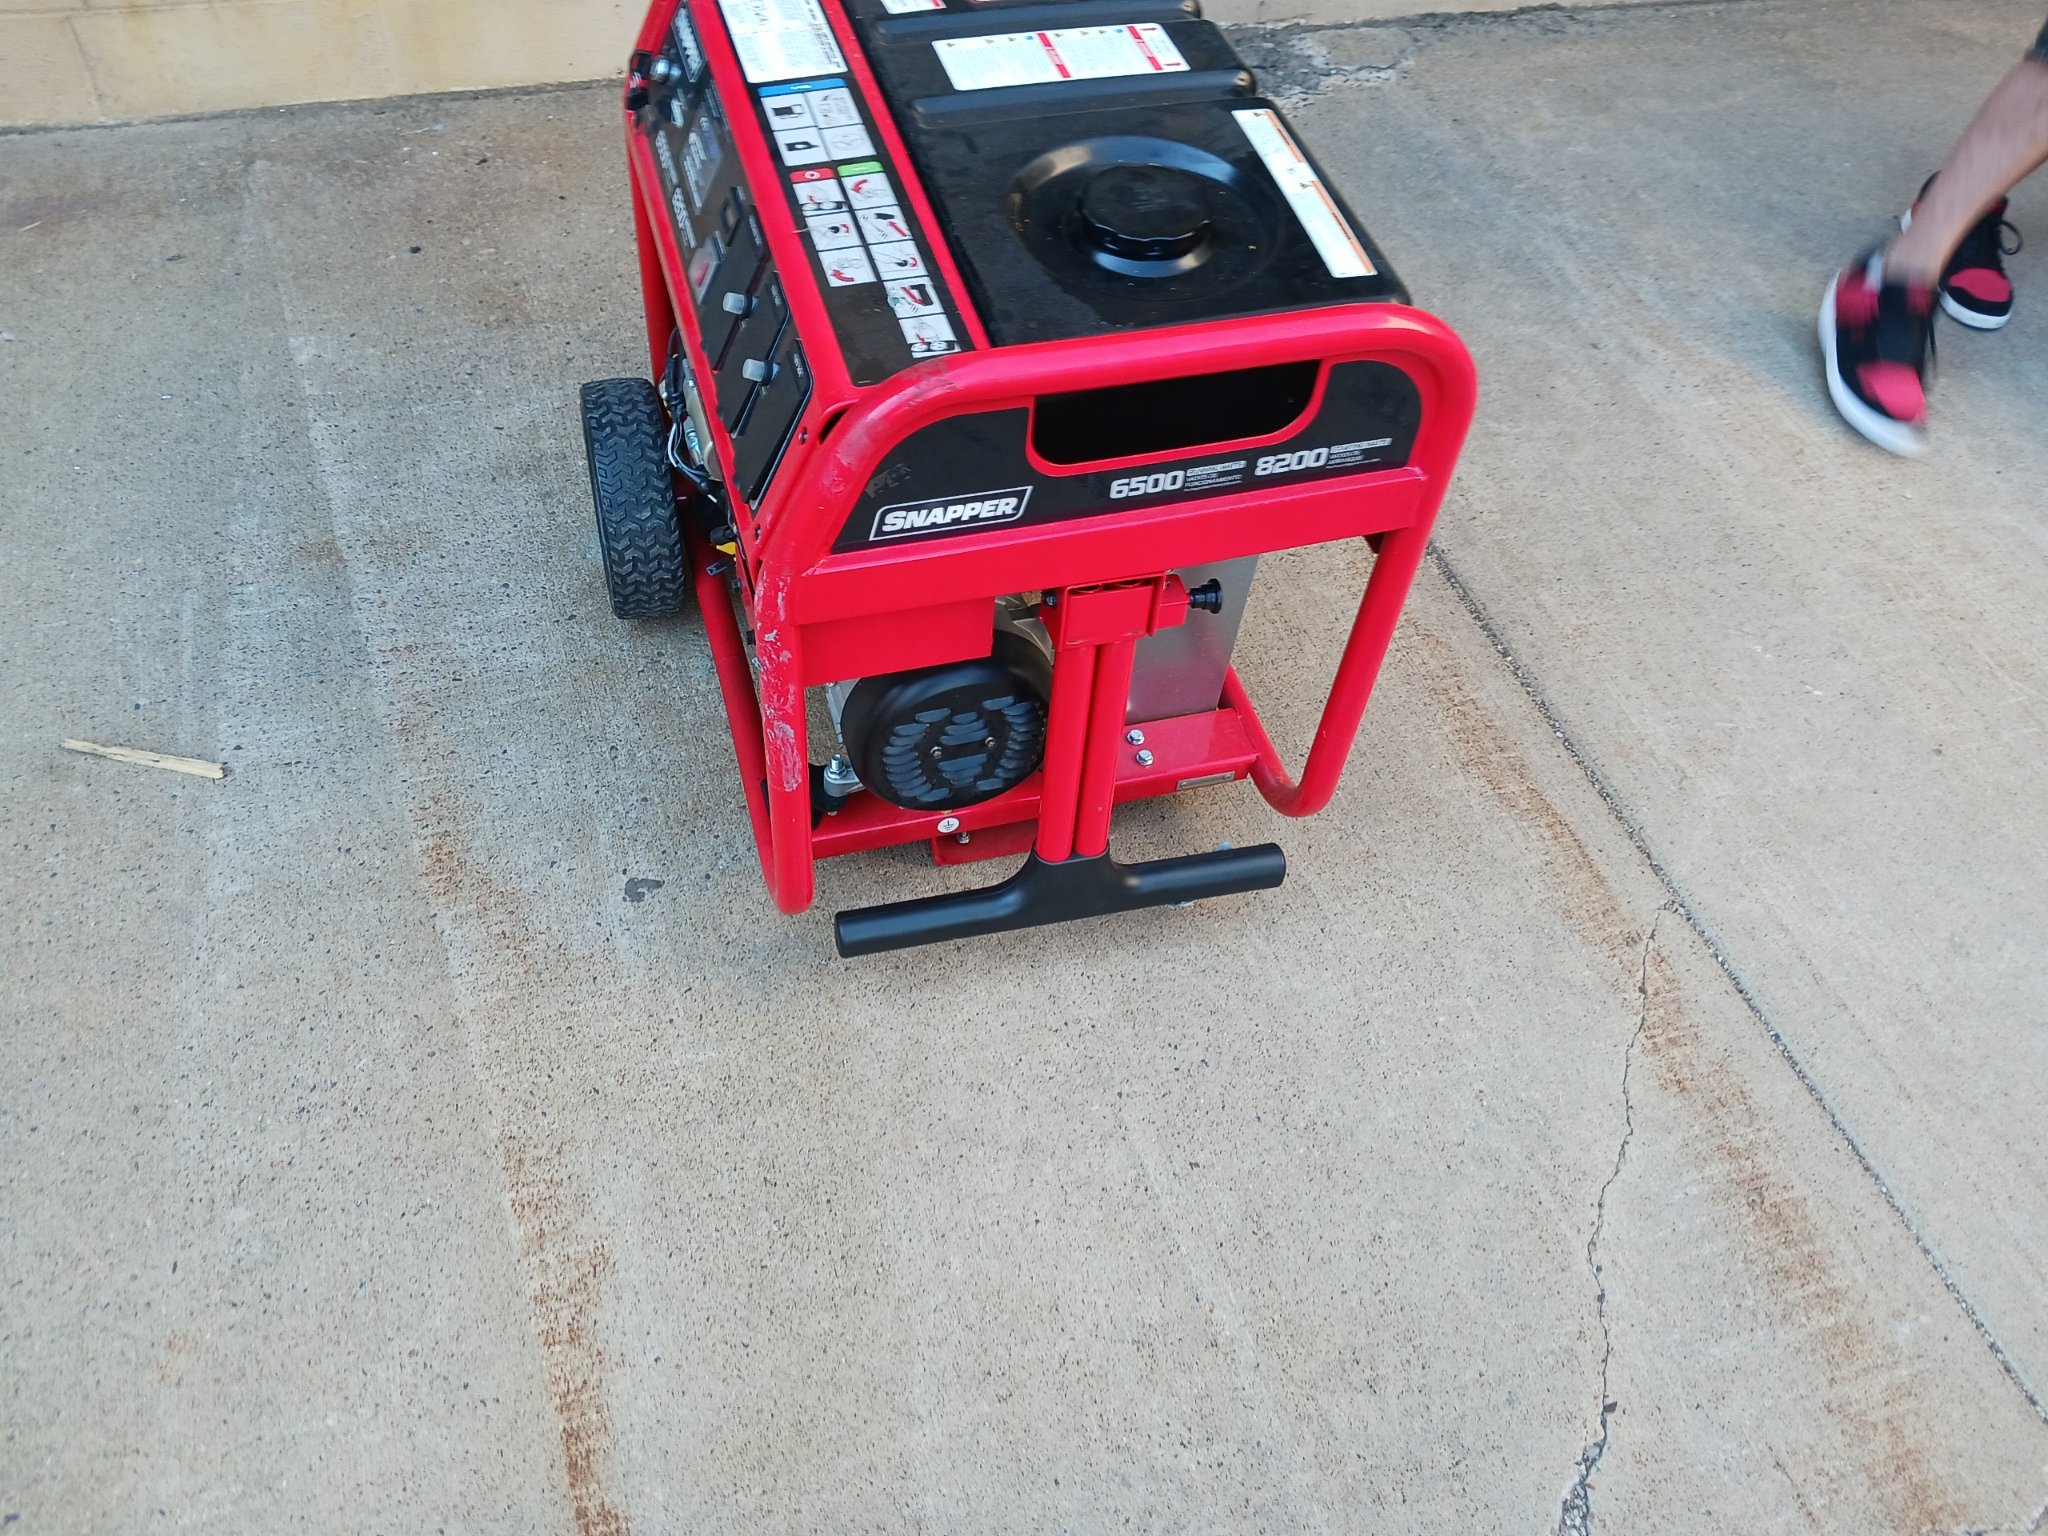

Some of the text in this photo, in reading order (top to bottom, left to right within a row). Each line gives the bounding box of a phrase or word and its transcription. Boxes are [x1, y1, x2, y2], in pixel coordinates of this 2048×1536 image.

[1254, 447, 1330, 476] 8200
[1109, 470, 1186, 499] 6500
[881, 497, 1018, 532] SNAPPER
